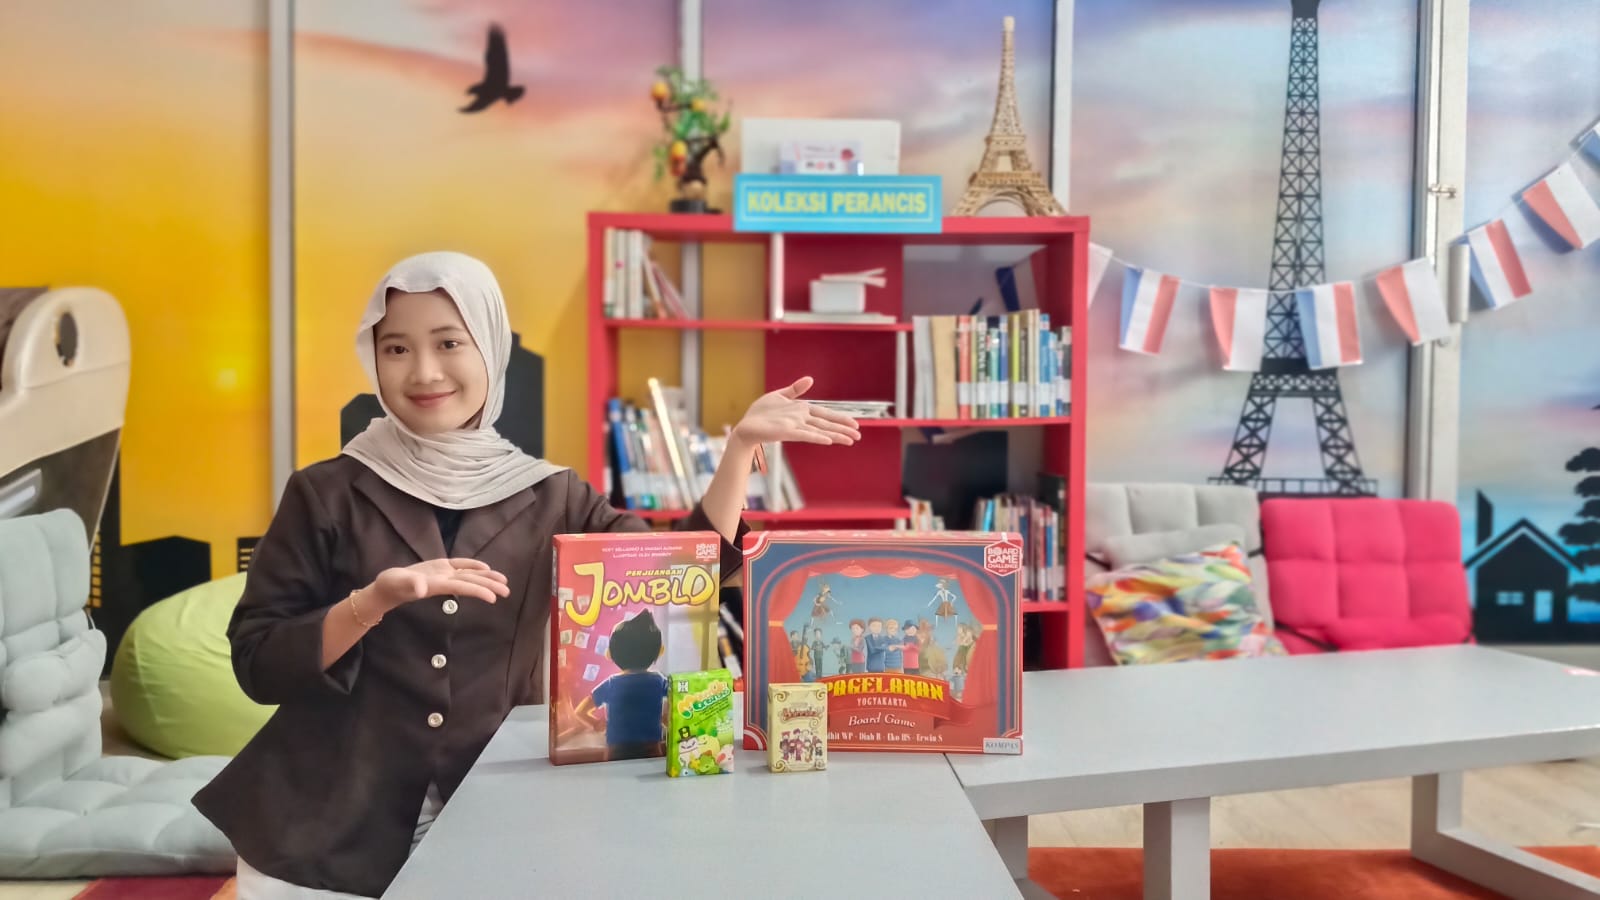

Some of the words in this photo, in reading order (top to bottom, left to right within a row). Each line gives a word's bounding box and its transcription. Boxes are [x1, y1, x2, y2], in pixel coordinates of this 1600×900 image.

[747, 191, 827, 213] KOLEKSI
[831, 192, 926, 214] PERANCIS
[987, 547, 1019, 555] BOARD
[987, 554, 1019, 564] GAME
[625, 568, 683, 577] PERJUANGAN
[564, 561, 716, 628] JOMBLO
[826, 677, 944, 701] PAGELARAN
[857, 697, 908, 707] YOGYAKARTA
[848, 712, 882, 727] Board
[884, 713, 916, 728] Game
[985, 741, 1019, 749] KOMPAS
